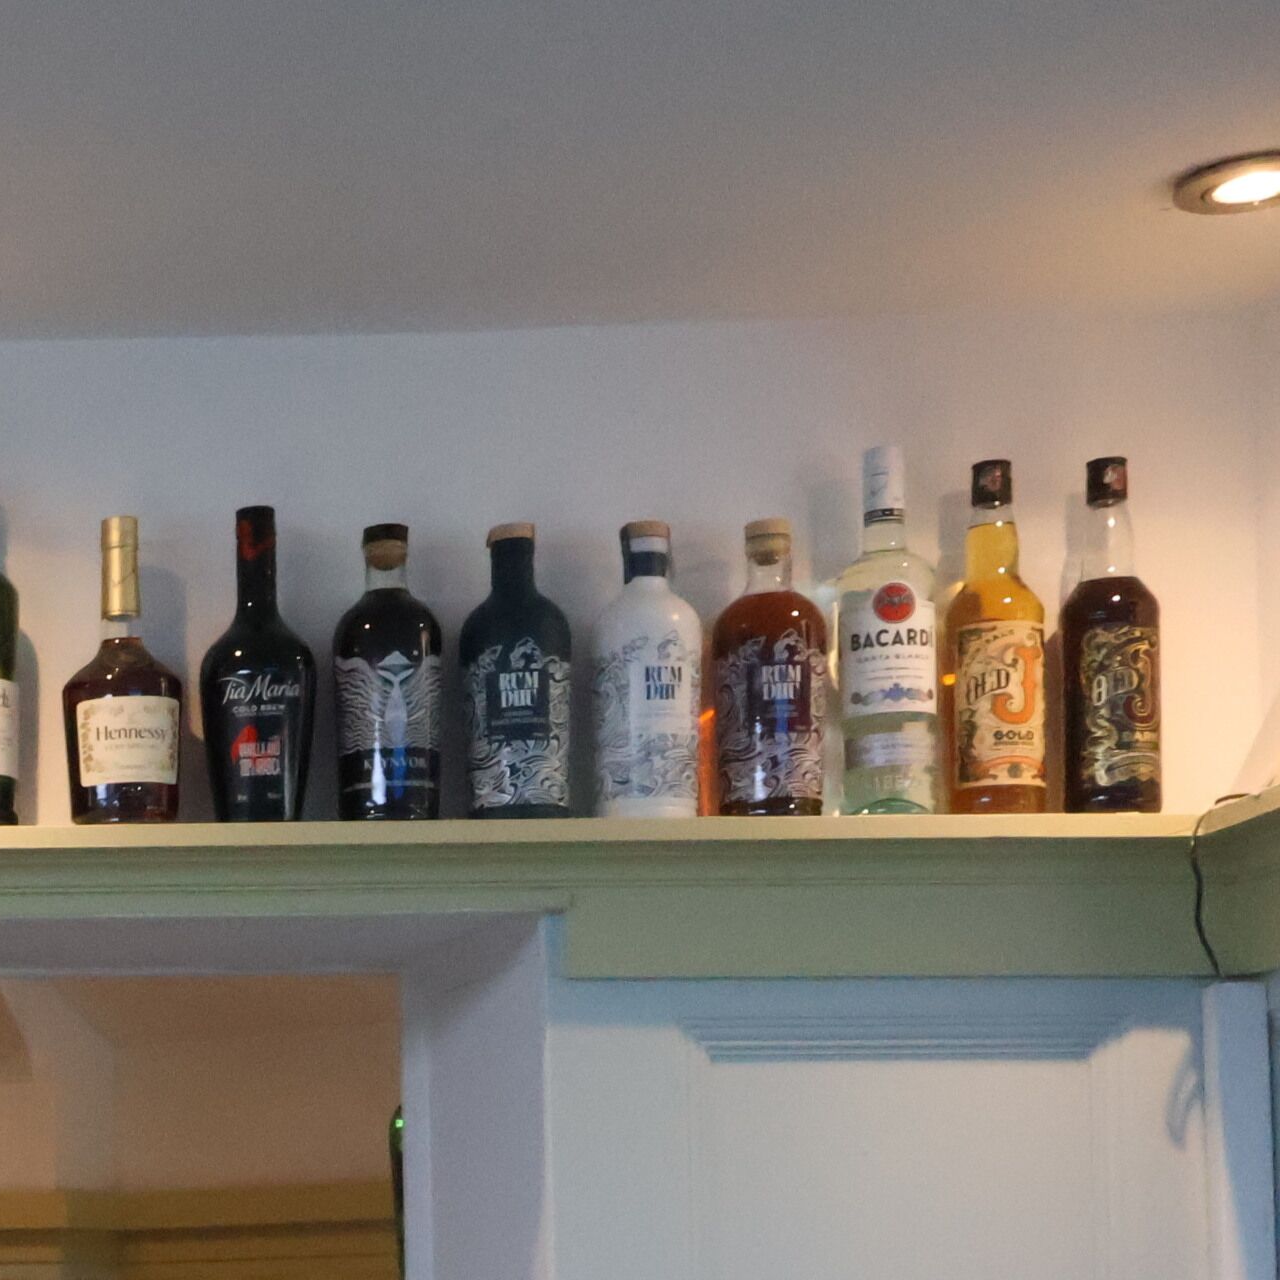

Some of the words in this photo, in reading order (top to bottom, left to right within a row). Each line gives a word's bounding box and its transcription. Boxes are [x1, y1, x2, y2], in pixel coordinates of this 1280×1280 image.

[499, 672, 539, 689] RUM
[644, 665, 683, 683] RUM
[761, 665, 802, 683] RUM
[220, 676, 246, 704] Tia
[245, 674, 300, 702] Maria
[95, 725, 169, 743] Hennessy
[992, 729, 1035, 741] GOLD
